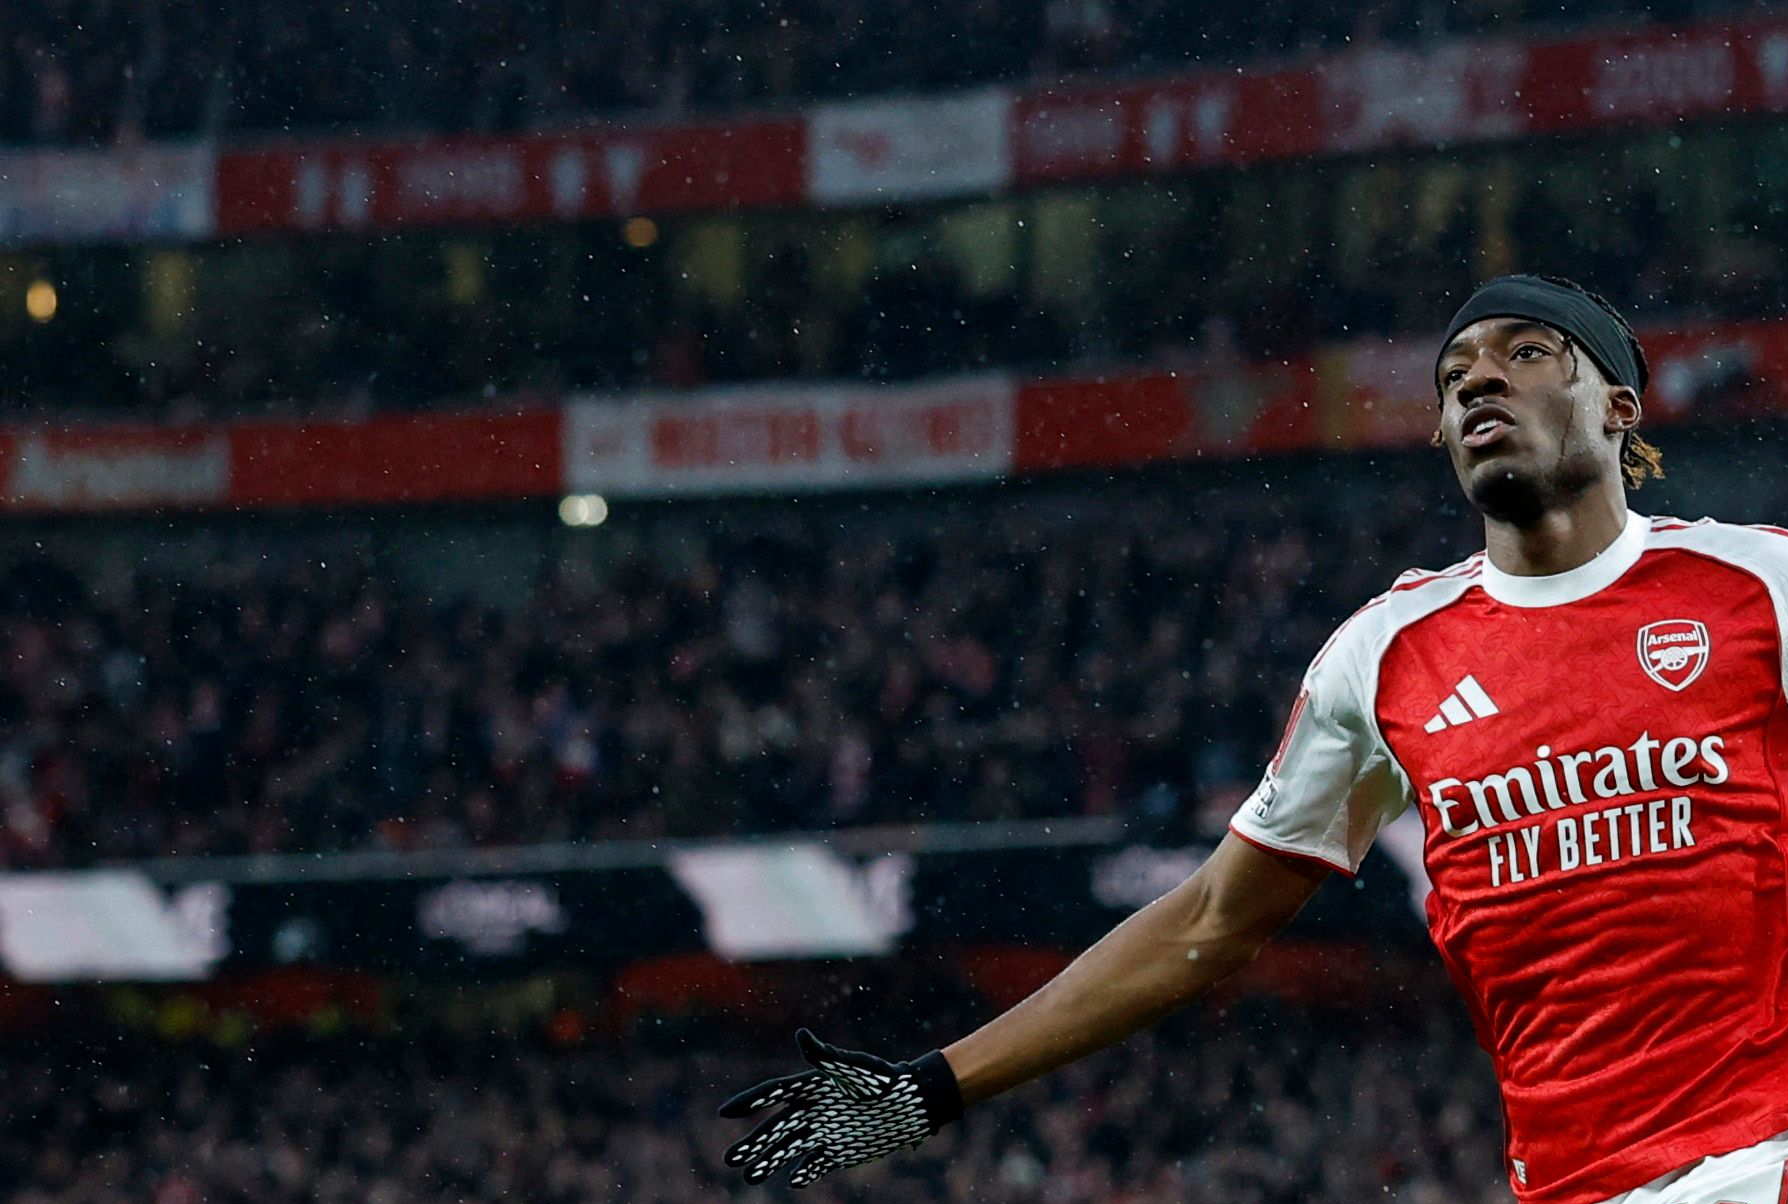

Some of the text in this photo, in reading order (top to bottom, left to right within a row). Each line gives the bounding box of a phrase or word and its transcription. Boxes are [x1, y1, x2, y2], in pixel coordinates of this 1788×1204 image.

[1647, 630, 1698, 647] Arsenal
[1428, 729, 1730, 838] Emirates
[1487, 796, 1696, 888] FLY BETTER
